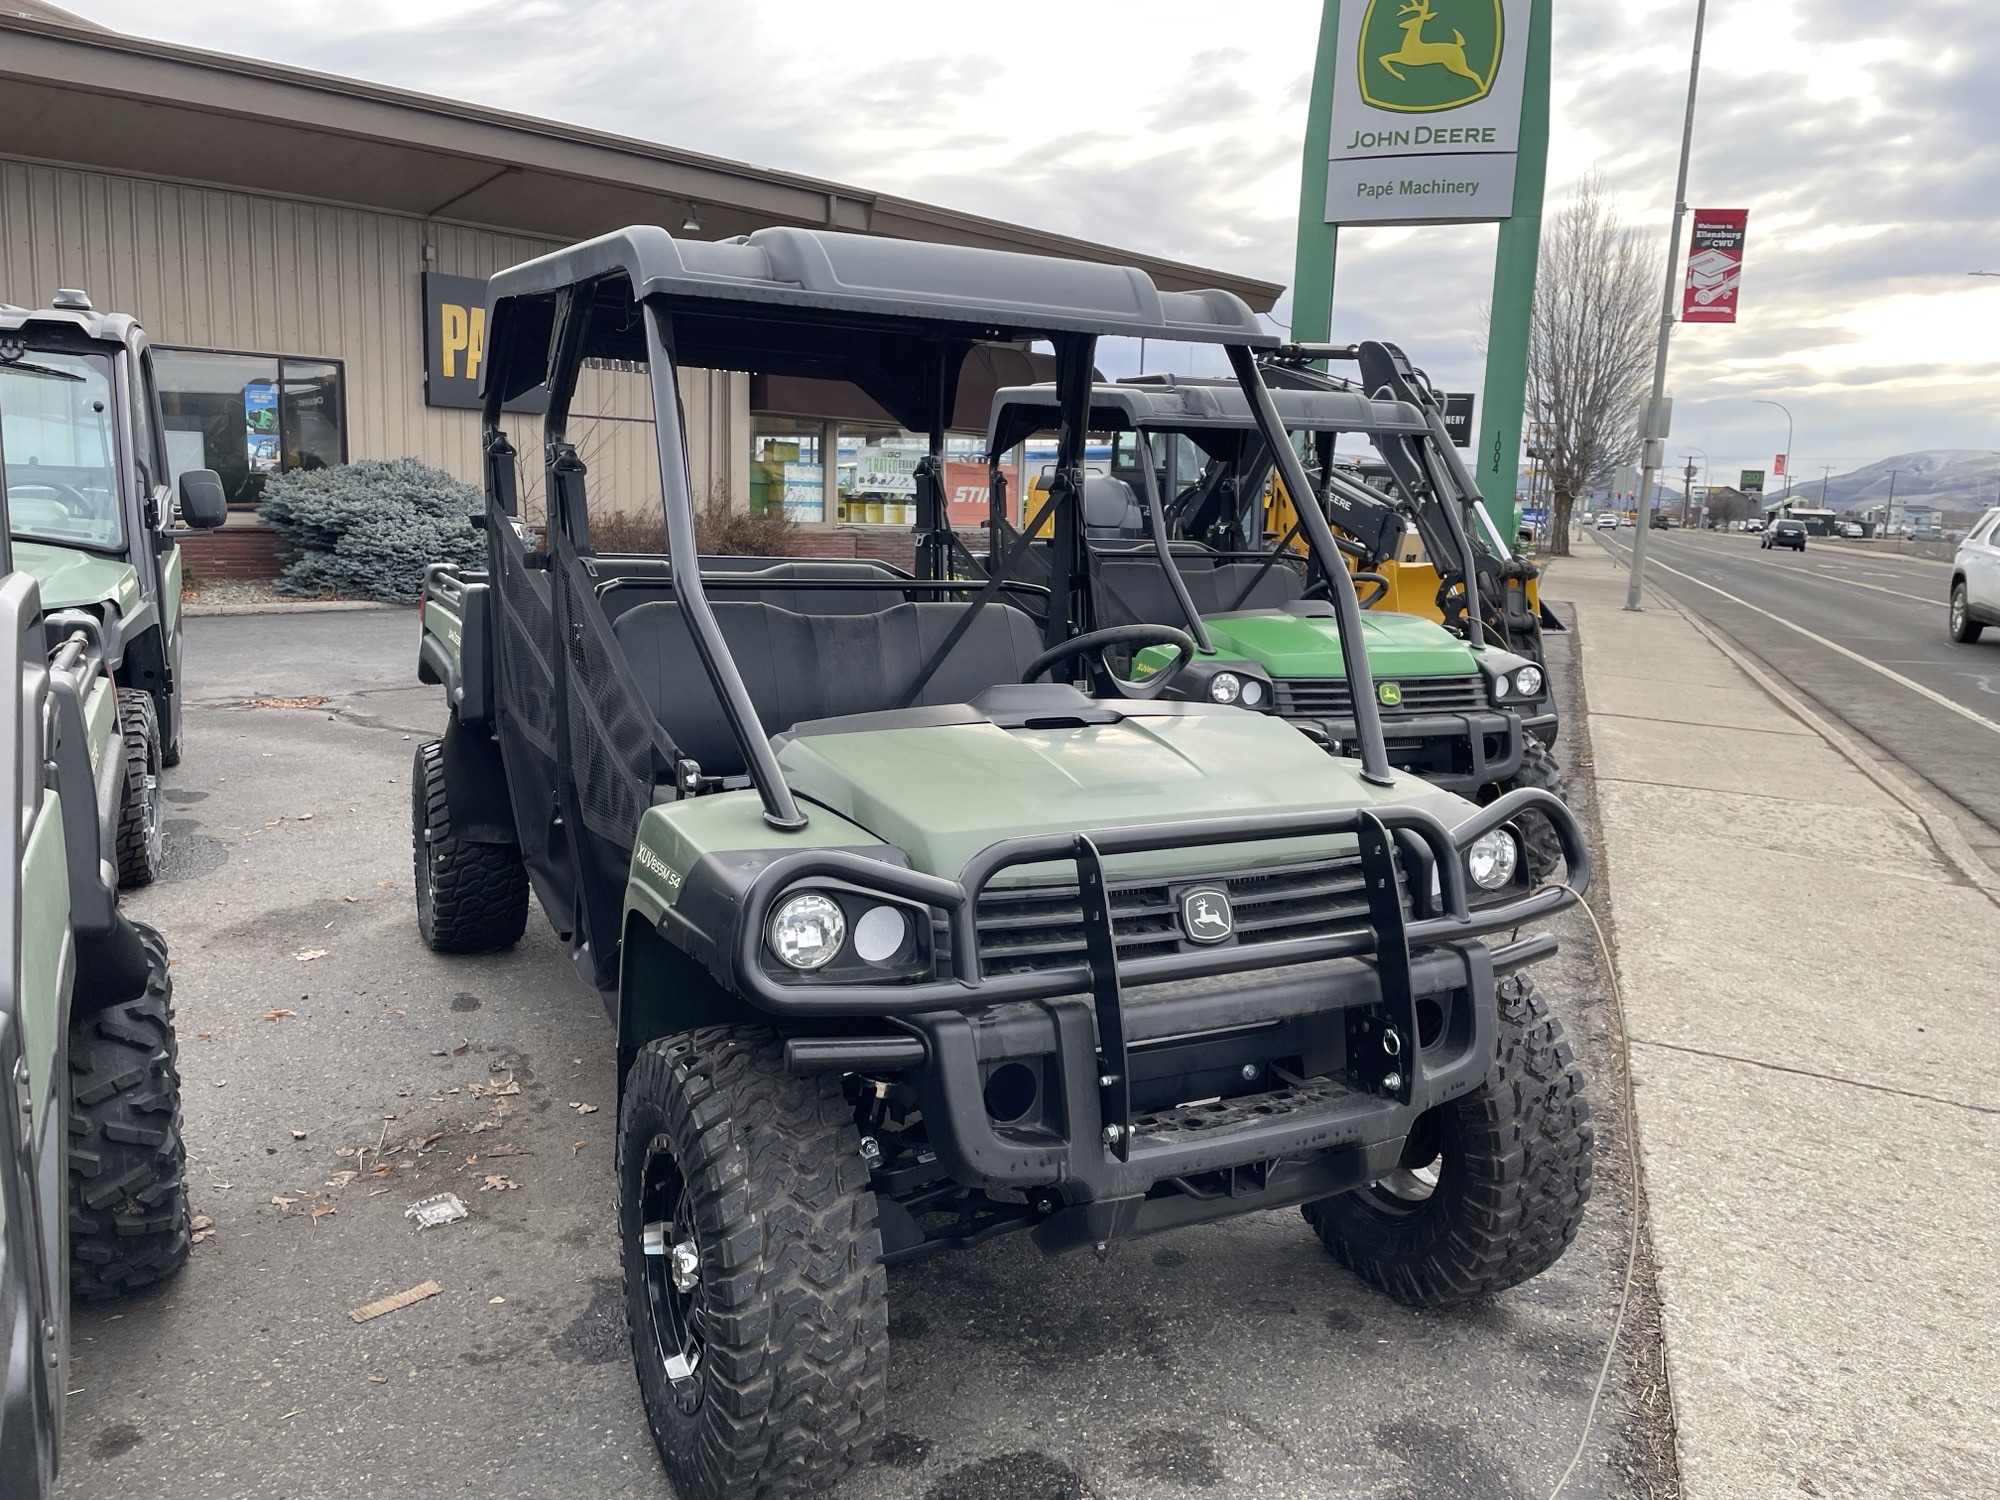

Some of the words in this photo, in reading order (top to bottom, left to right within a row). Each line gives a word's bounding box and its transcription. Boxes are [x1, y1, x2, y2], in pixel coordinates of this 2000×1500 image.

[1347, 130, 1410, 150] JOHN
[1414, 126, 1497, 145] DEERE
[1356, 181, 1394, 200] Papé
[1399, 179, 1480, 197] Machinery
[1696, 230, 1742, 240] Ellensburg
[1491, 430, 1502, 474] 1004
[874, 457, 898, 474] RATED
[636, 843, 671, 881] XUV855M
[668, 873, 681, 889] S4
